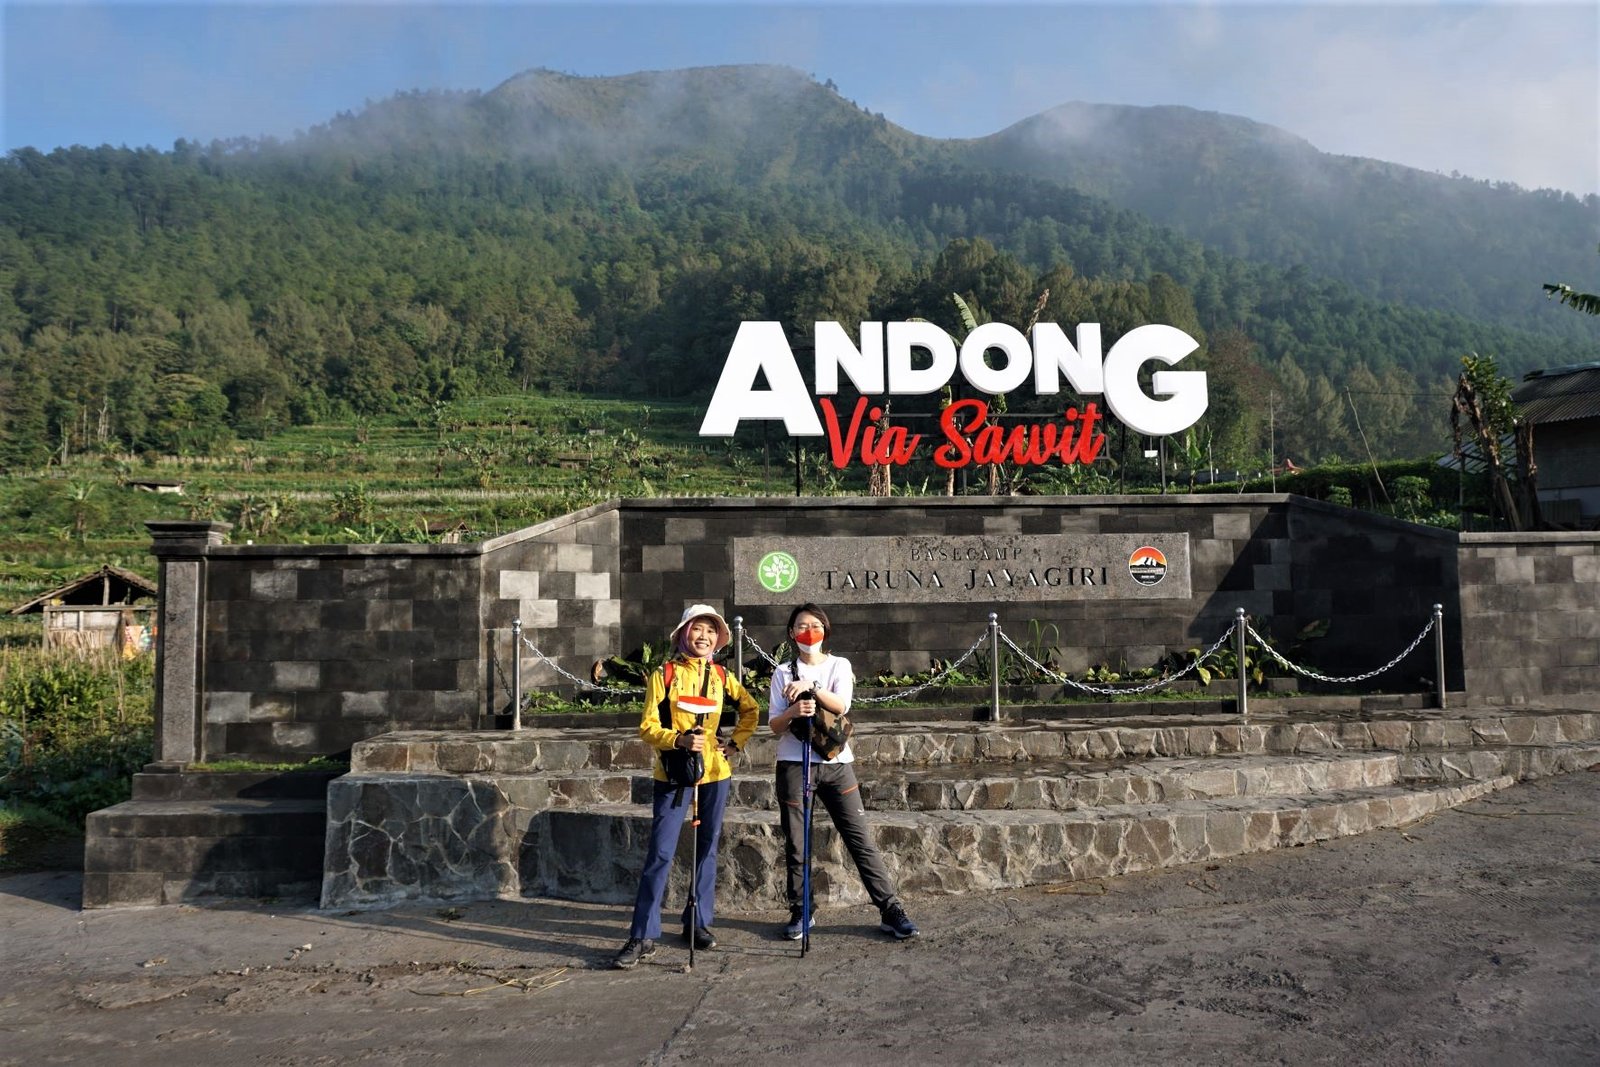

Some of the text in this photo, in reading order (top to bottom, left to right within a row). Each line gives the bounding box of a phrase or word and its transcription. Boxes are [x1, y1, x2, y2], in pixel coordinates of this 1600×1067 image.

[699, 320, 1209, 437] ANDONG
[820, 396, 1104, 469] Via Sawit
[821, 566, 1108, 591] TARUNA JAYAGIRI
[911, 547, 1022, 561] BASECAMP
